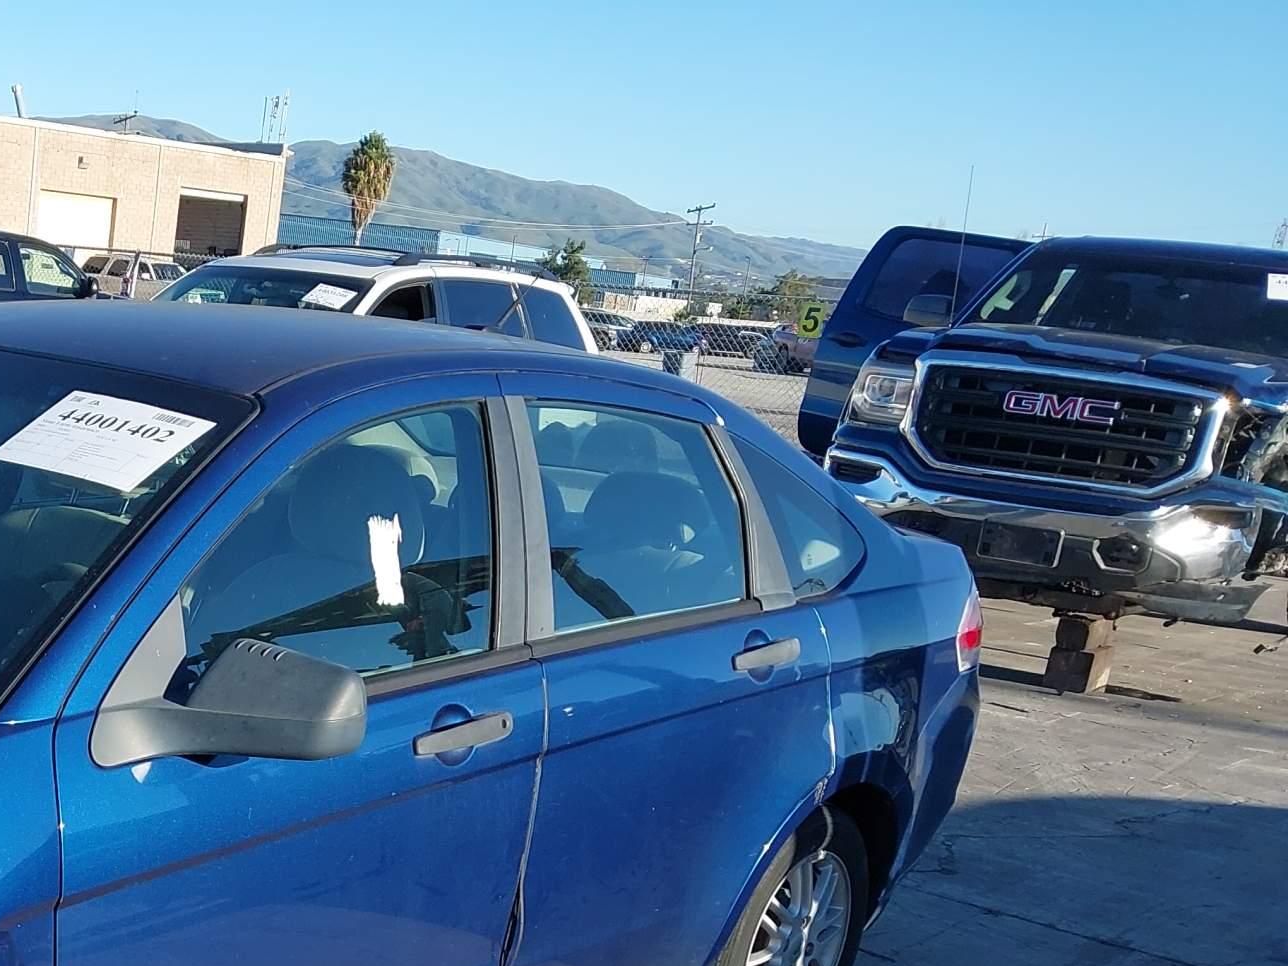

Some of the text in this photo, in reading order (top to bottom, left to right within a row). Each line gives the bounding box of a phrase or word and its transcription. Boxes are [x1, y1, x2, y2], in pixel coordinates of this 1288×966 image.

[802, 307, 821, 332] 5
[58, 408, 176, 443] 44001402
[1003, 390, 1121, 426] GMC
